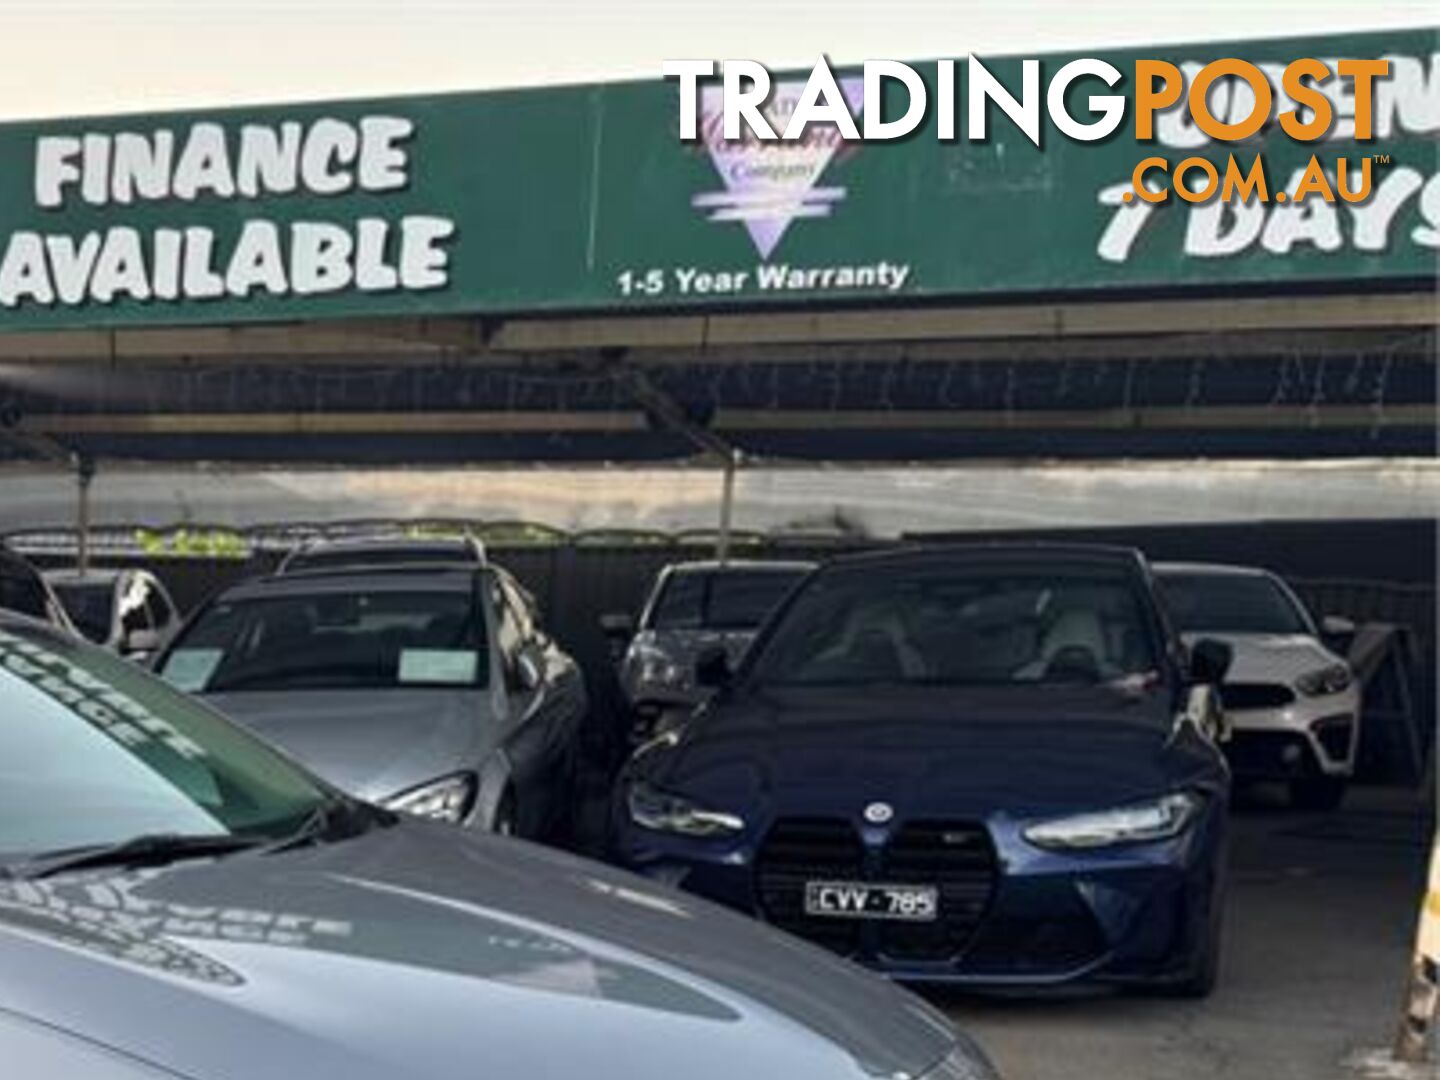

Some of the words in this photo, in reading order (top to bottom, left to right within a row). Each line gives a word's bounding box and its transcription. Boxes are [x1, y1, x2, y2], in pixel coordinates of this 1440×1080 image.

[34, 115, 413, 207] FINANCE
[617, 269, 664, 296] 1-5
[675, 267, 750, 294] Year
[756, 260, 910, 291] Warranty
